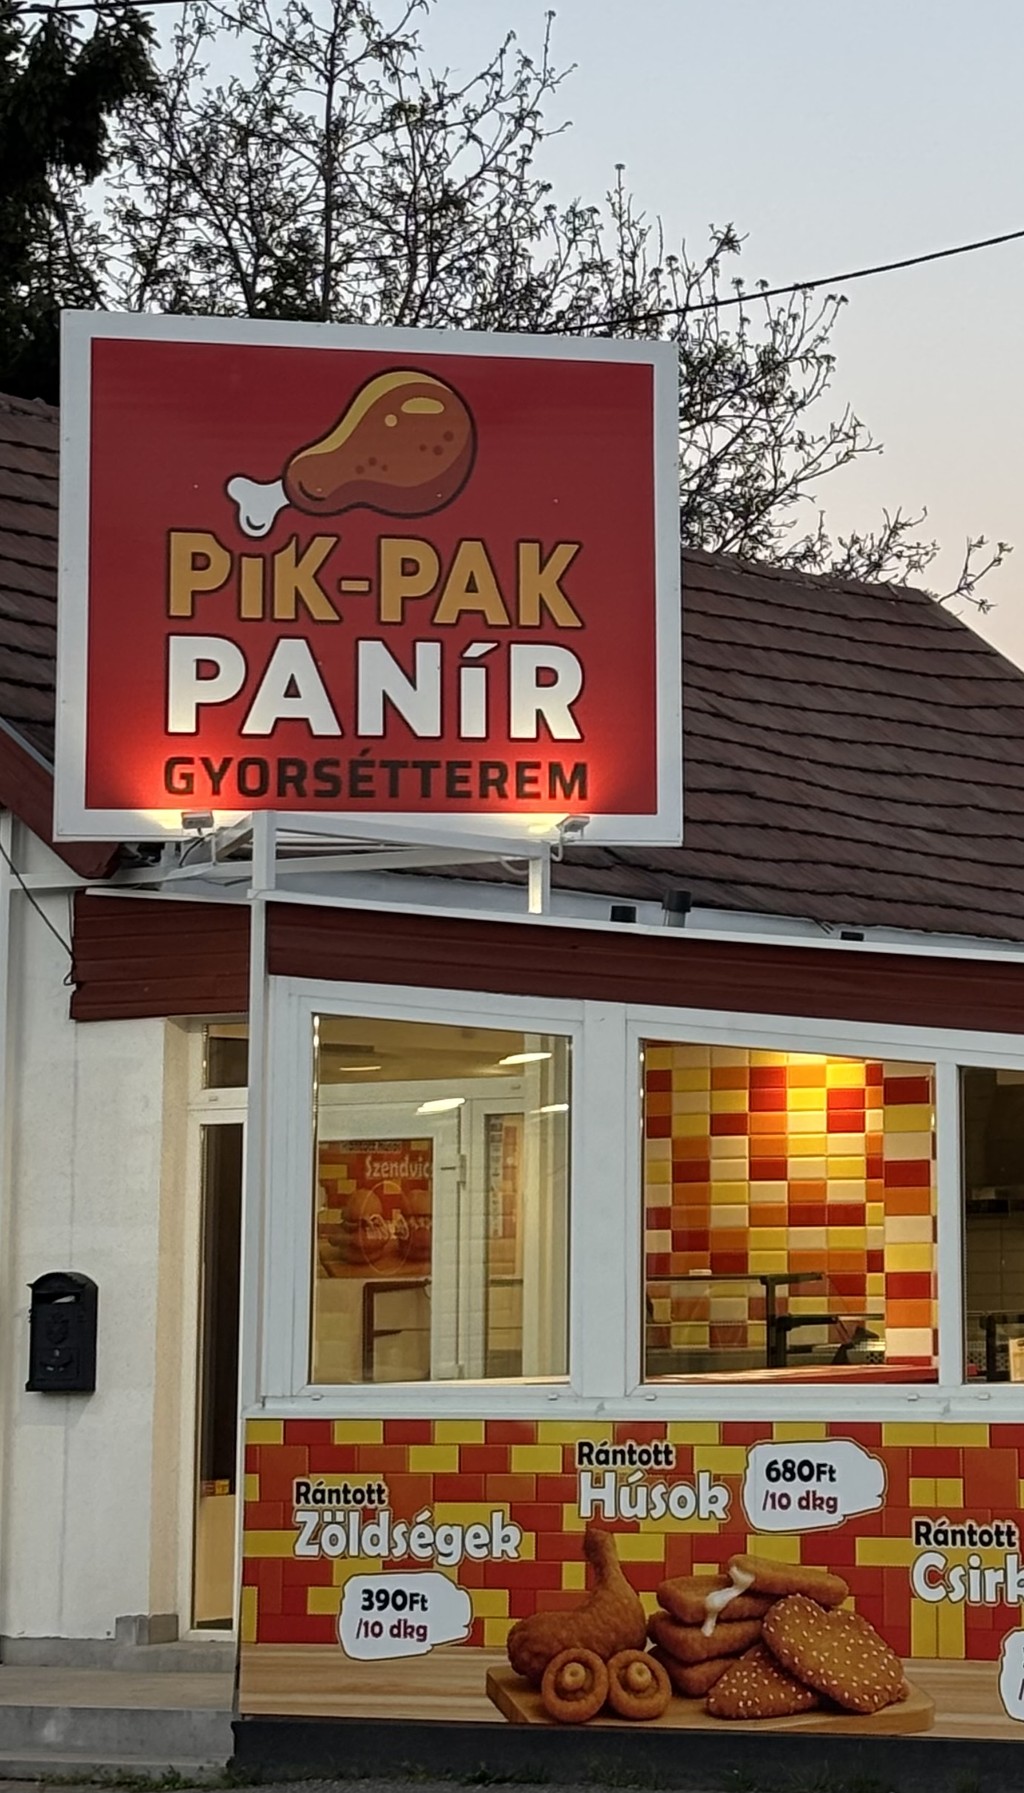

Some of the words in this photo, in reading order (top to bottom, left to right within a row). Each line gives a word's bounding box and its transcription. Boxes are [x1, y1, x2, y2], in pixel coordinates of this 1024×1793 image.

[164, 748, 589, 801] GYORSÉTTEREM
[577, 1441, 674, 1466] Rántott
[765, 1459, 837, 1483] 680Ft
[295, 1481, 386, 1505] Rántott
[578, 1469, 730, 1520] Húsok
[762, 1490, 790, 1511] /10
[797, 1489, 838, 1514] dkg
[293, 1508, 523, 1566] Zöldségek
[914, 1520, 1017, 1548] Rántott
[361, 1588, 428, 1612] 390Ft
[356, 1618, 383, 1639] /10
[389, 1619, 428, 1642] dkg
